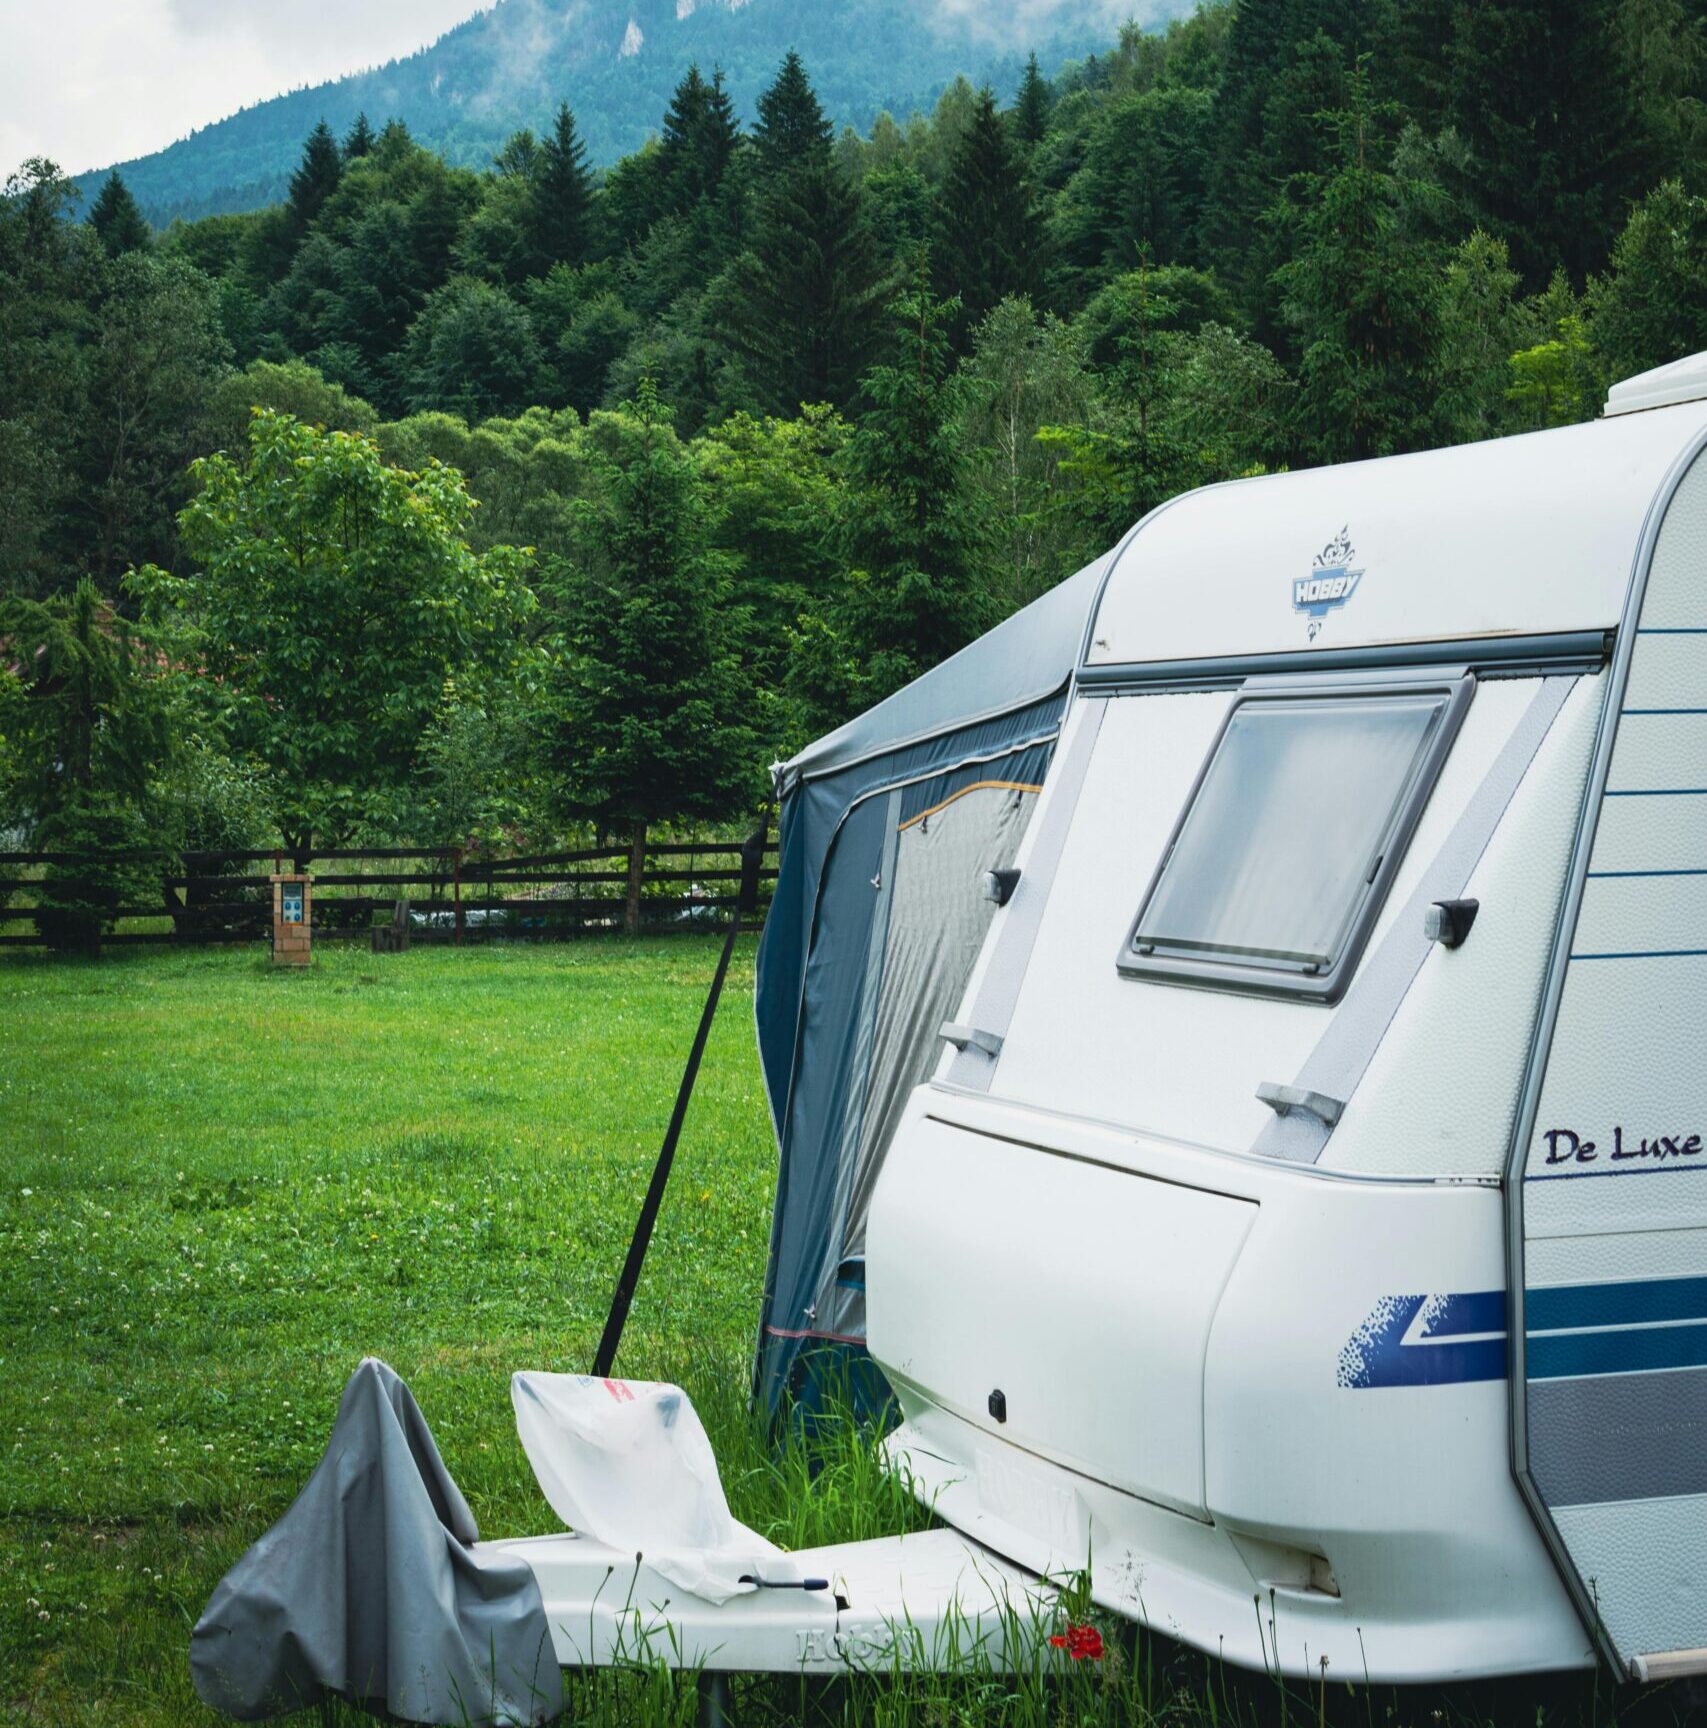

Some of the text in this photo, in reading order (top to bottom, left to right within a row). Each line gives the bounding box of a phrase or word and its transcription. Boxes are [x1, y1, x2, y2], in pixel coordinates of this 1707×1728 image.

[1296, 574, 1361, 603] HOBBY
[1543, 1126, 1704, 1164] De Luxe
